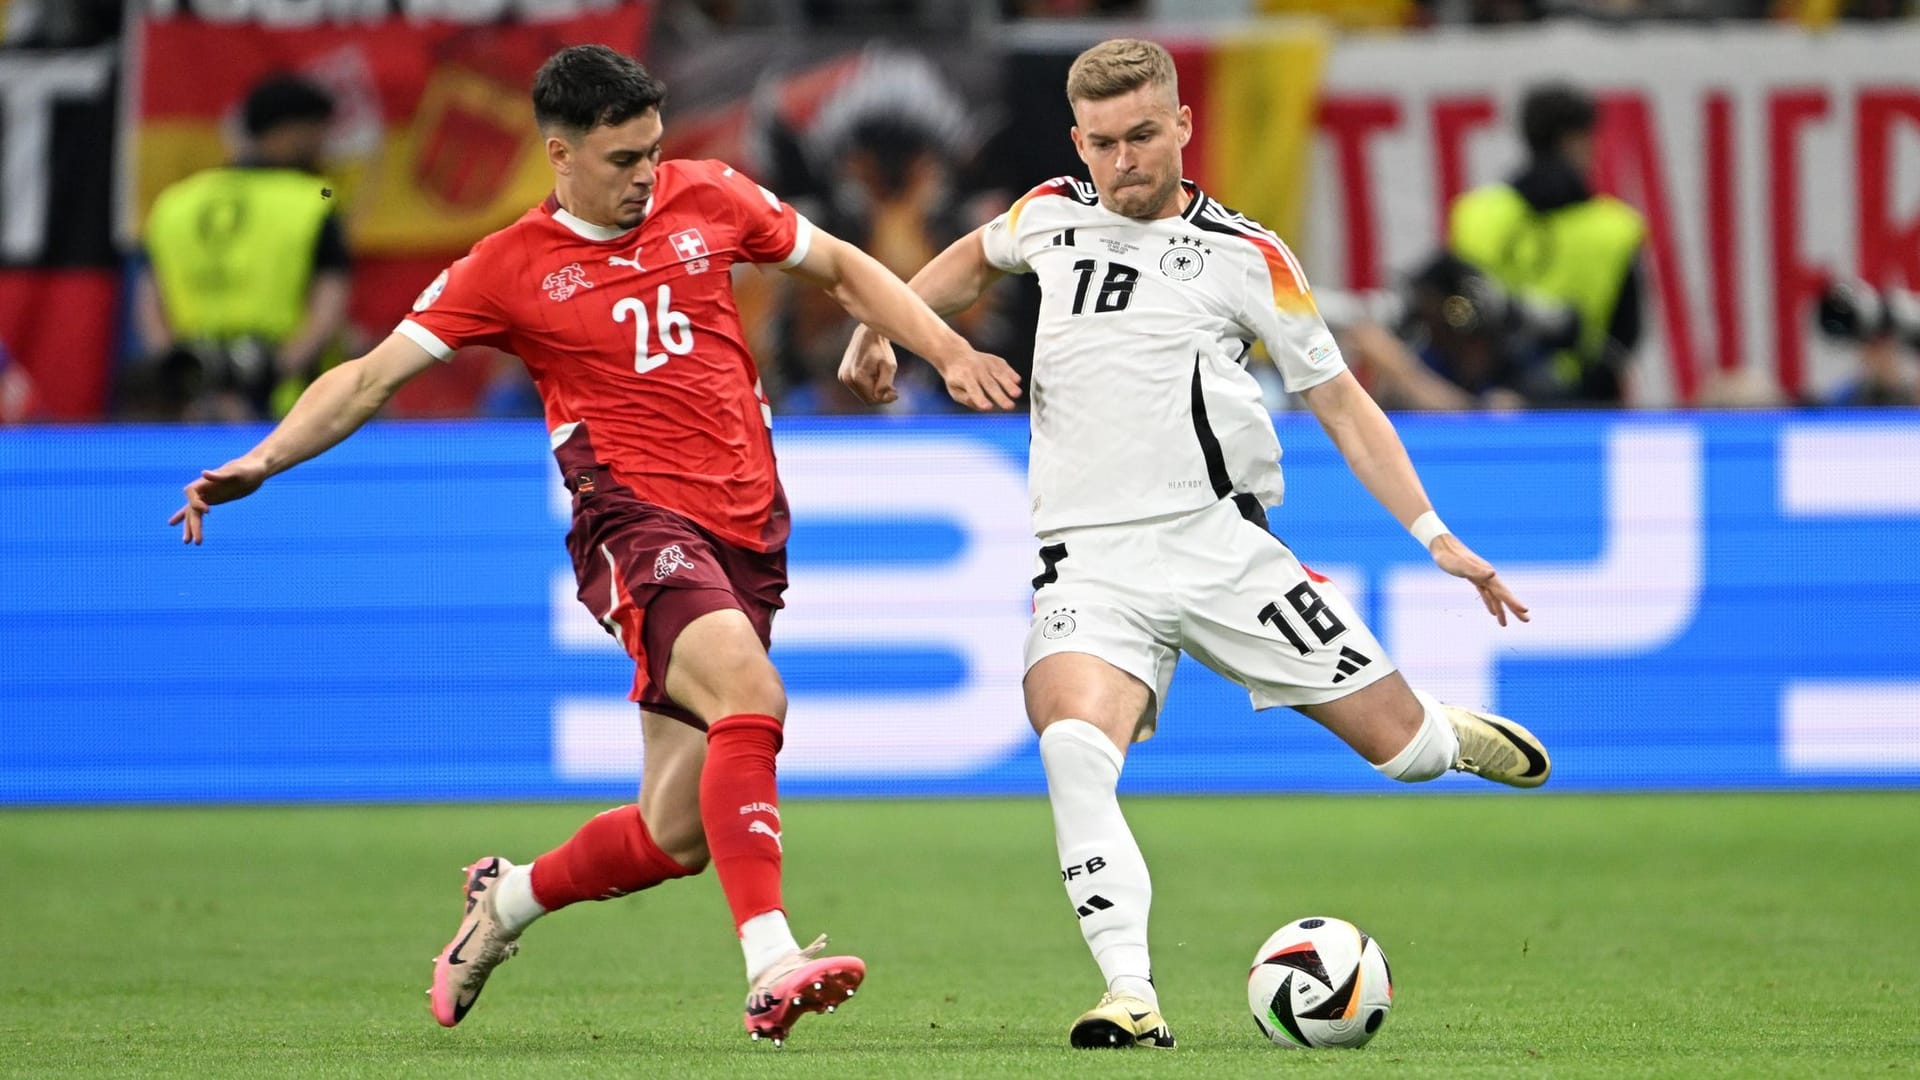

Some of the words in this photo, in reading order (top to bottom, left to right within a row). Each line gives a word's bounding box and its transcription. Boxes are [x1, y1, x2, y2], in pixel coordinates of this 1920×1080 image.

[1072, 258, 1142, 317] 18
[612, 284, 694, 374] 26
[1257, 580, 1349, 657] 18
